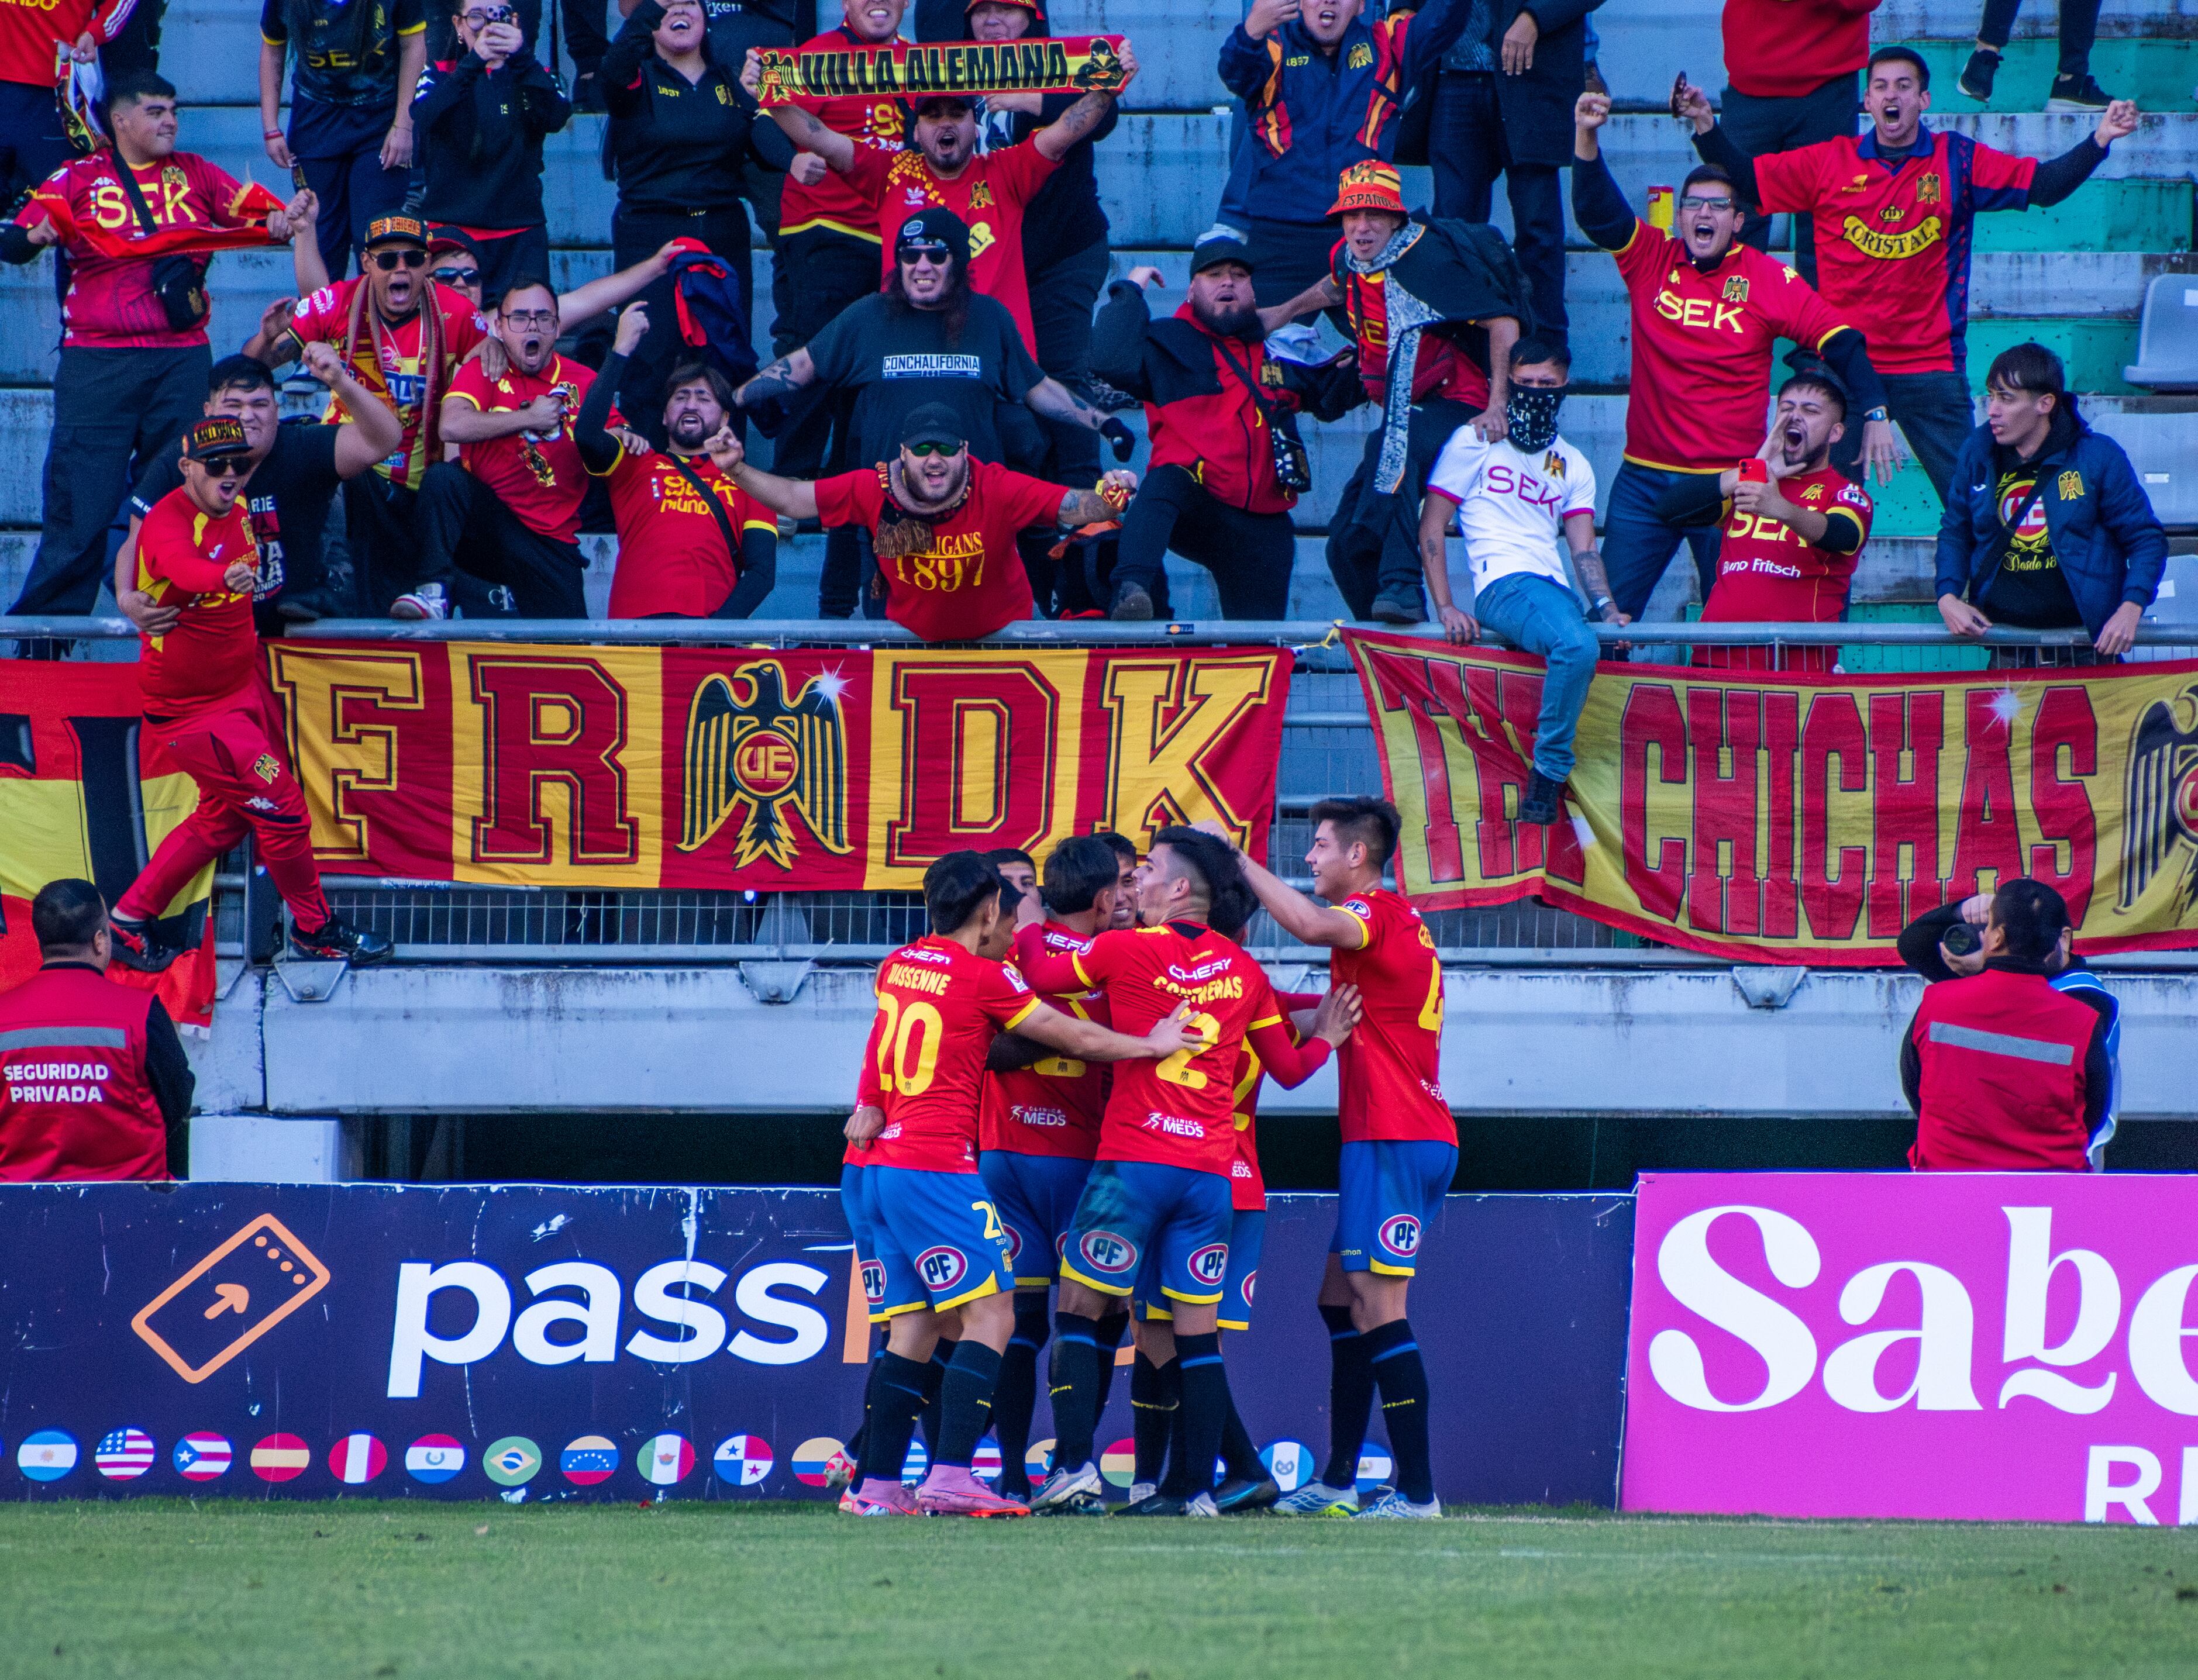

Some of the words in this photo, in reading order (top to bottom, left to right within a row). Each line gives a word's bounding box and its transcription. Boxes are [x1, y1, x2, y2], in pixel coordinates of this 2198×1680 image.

[799, 49, 901, 96] VILLA
[906, 42, 1068, 93] ALEMANA
[96, 182, 197, 229] SEK
[1851, 225, 1934, 254] CRISTAL
[1656, 291, 1745, 334] SEK
[883, 355, 980, 370] CONCHALIFORNIA
[1487, 466, 1563, 519] SEK
[895, 550, 986, 592] 1897
[1752, 558, 1801, 578] Fritsch
[740, 745, 794, 780] UE
[1620, 682, 2097, 940] CHICHAS
[1170, 959, 1232, 981] CHERY
[877, 991, 943, 1096] 20
[3, 1064, 108, 1082] SEGURIDAD
[10, 1086, 103, 1103] PRIVADA
[1022, 1112, 1066, 1127] MEDS
[1162, 1121, 1204, 1138] MEDS
[1232, 1165, 1253, 1178] EDS
[1394, 1223, 1415, 1249] PF
[1091, 1239, 1120, 1265] PF
[1203, 1250, 1225, 1277] PF
[924, 1254, 951, 1283] PF
